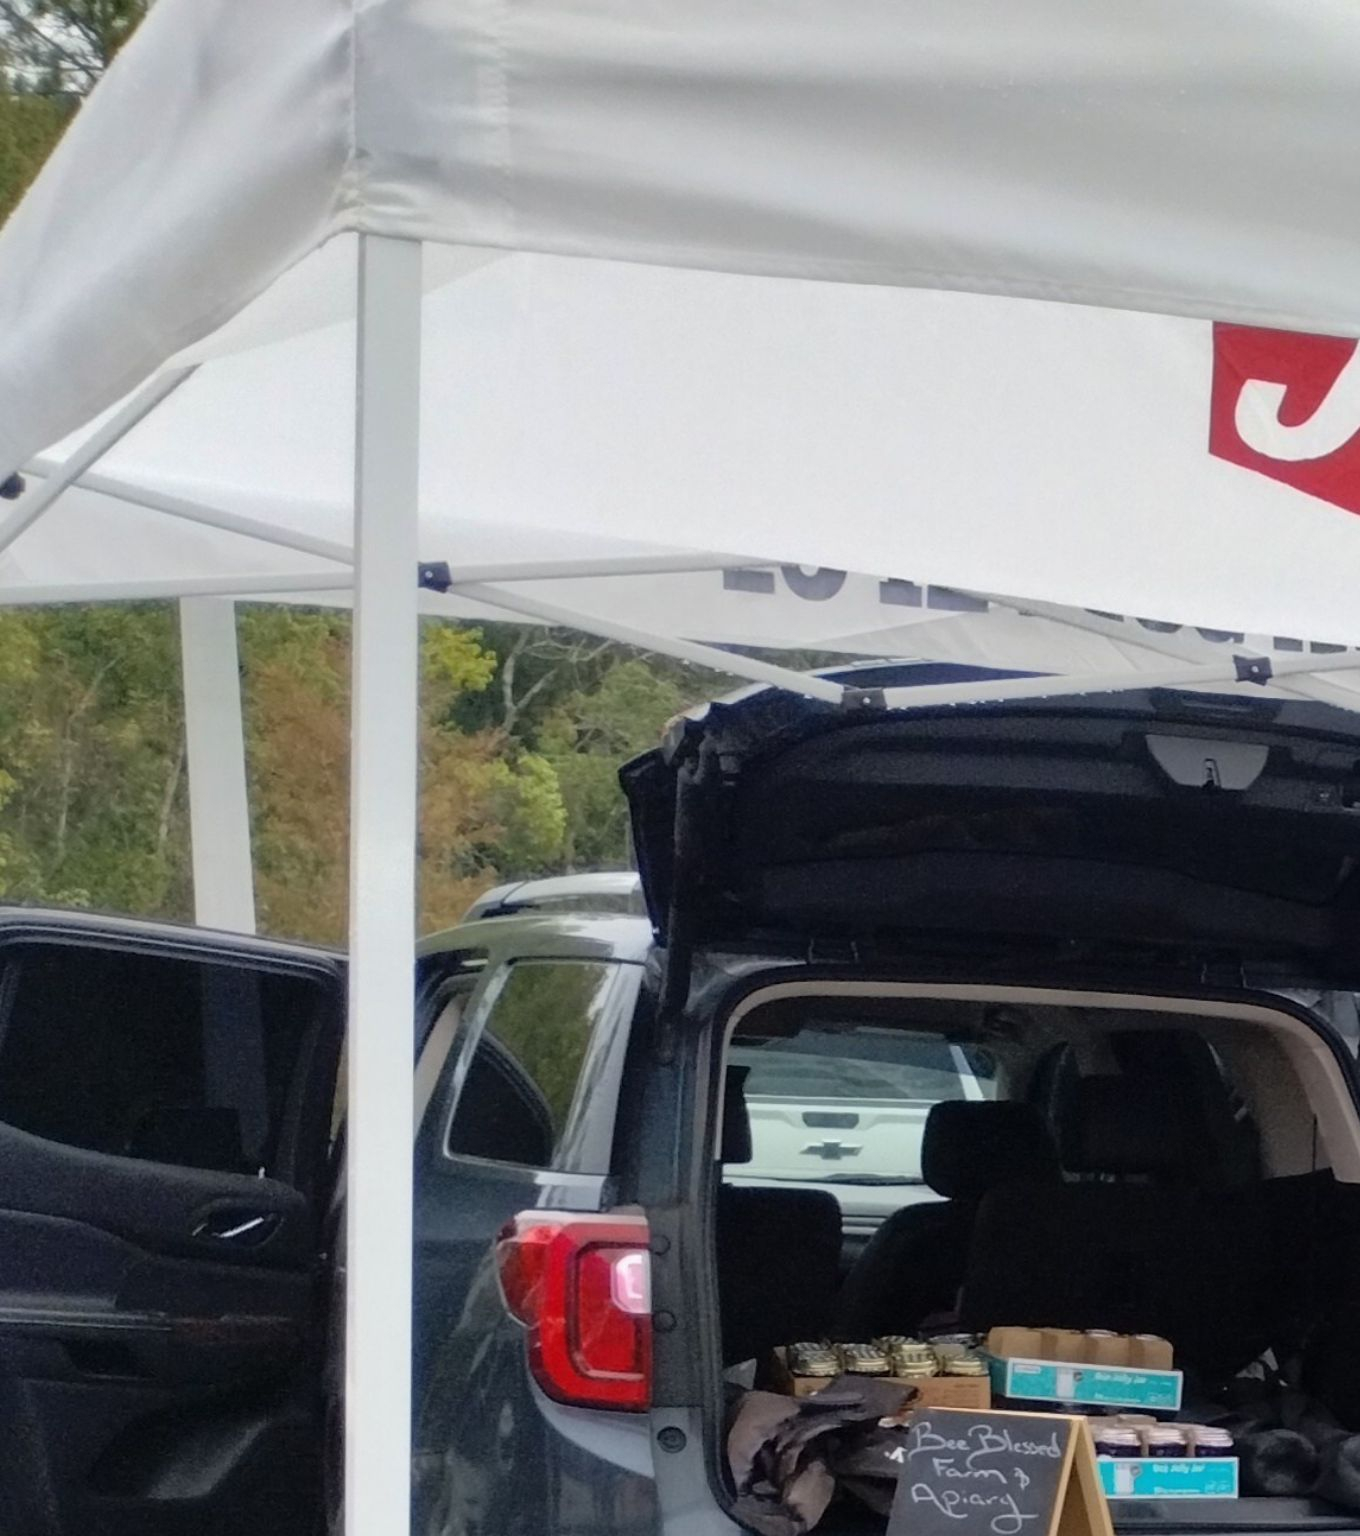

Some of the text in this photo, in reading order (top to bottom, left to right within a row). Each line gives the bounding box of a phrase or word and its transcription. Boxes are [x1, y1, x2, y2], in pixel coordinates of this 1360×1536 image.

[908, 1422, 1061, 1470] Bee Blessed
[932, 1458, 1007, 1484] Farm
[911, 1483, 1040, 1534] Apiary
